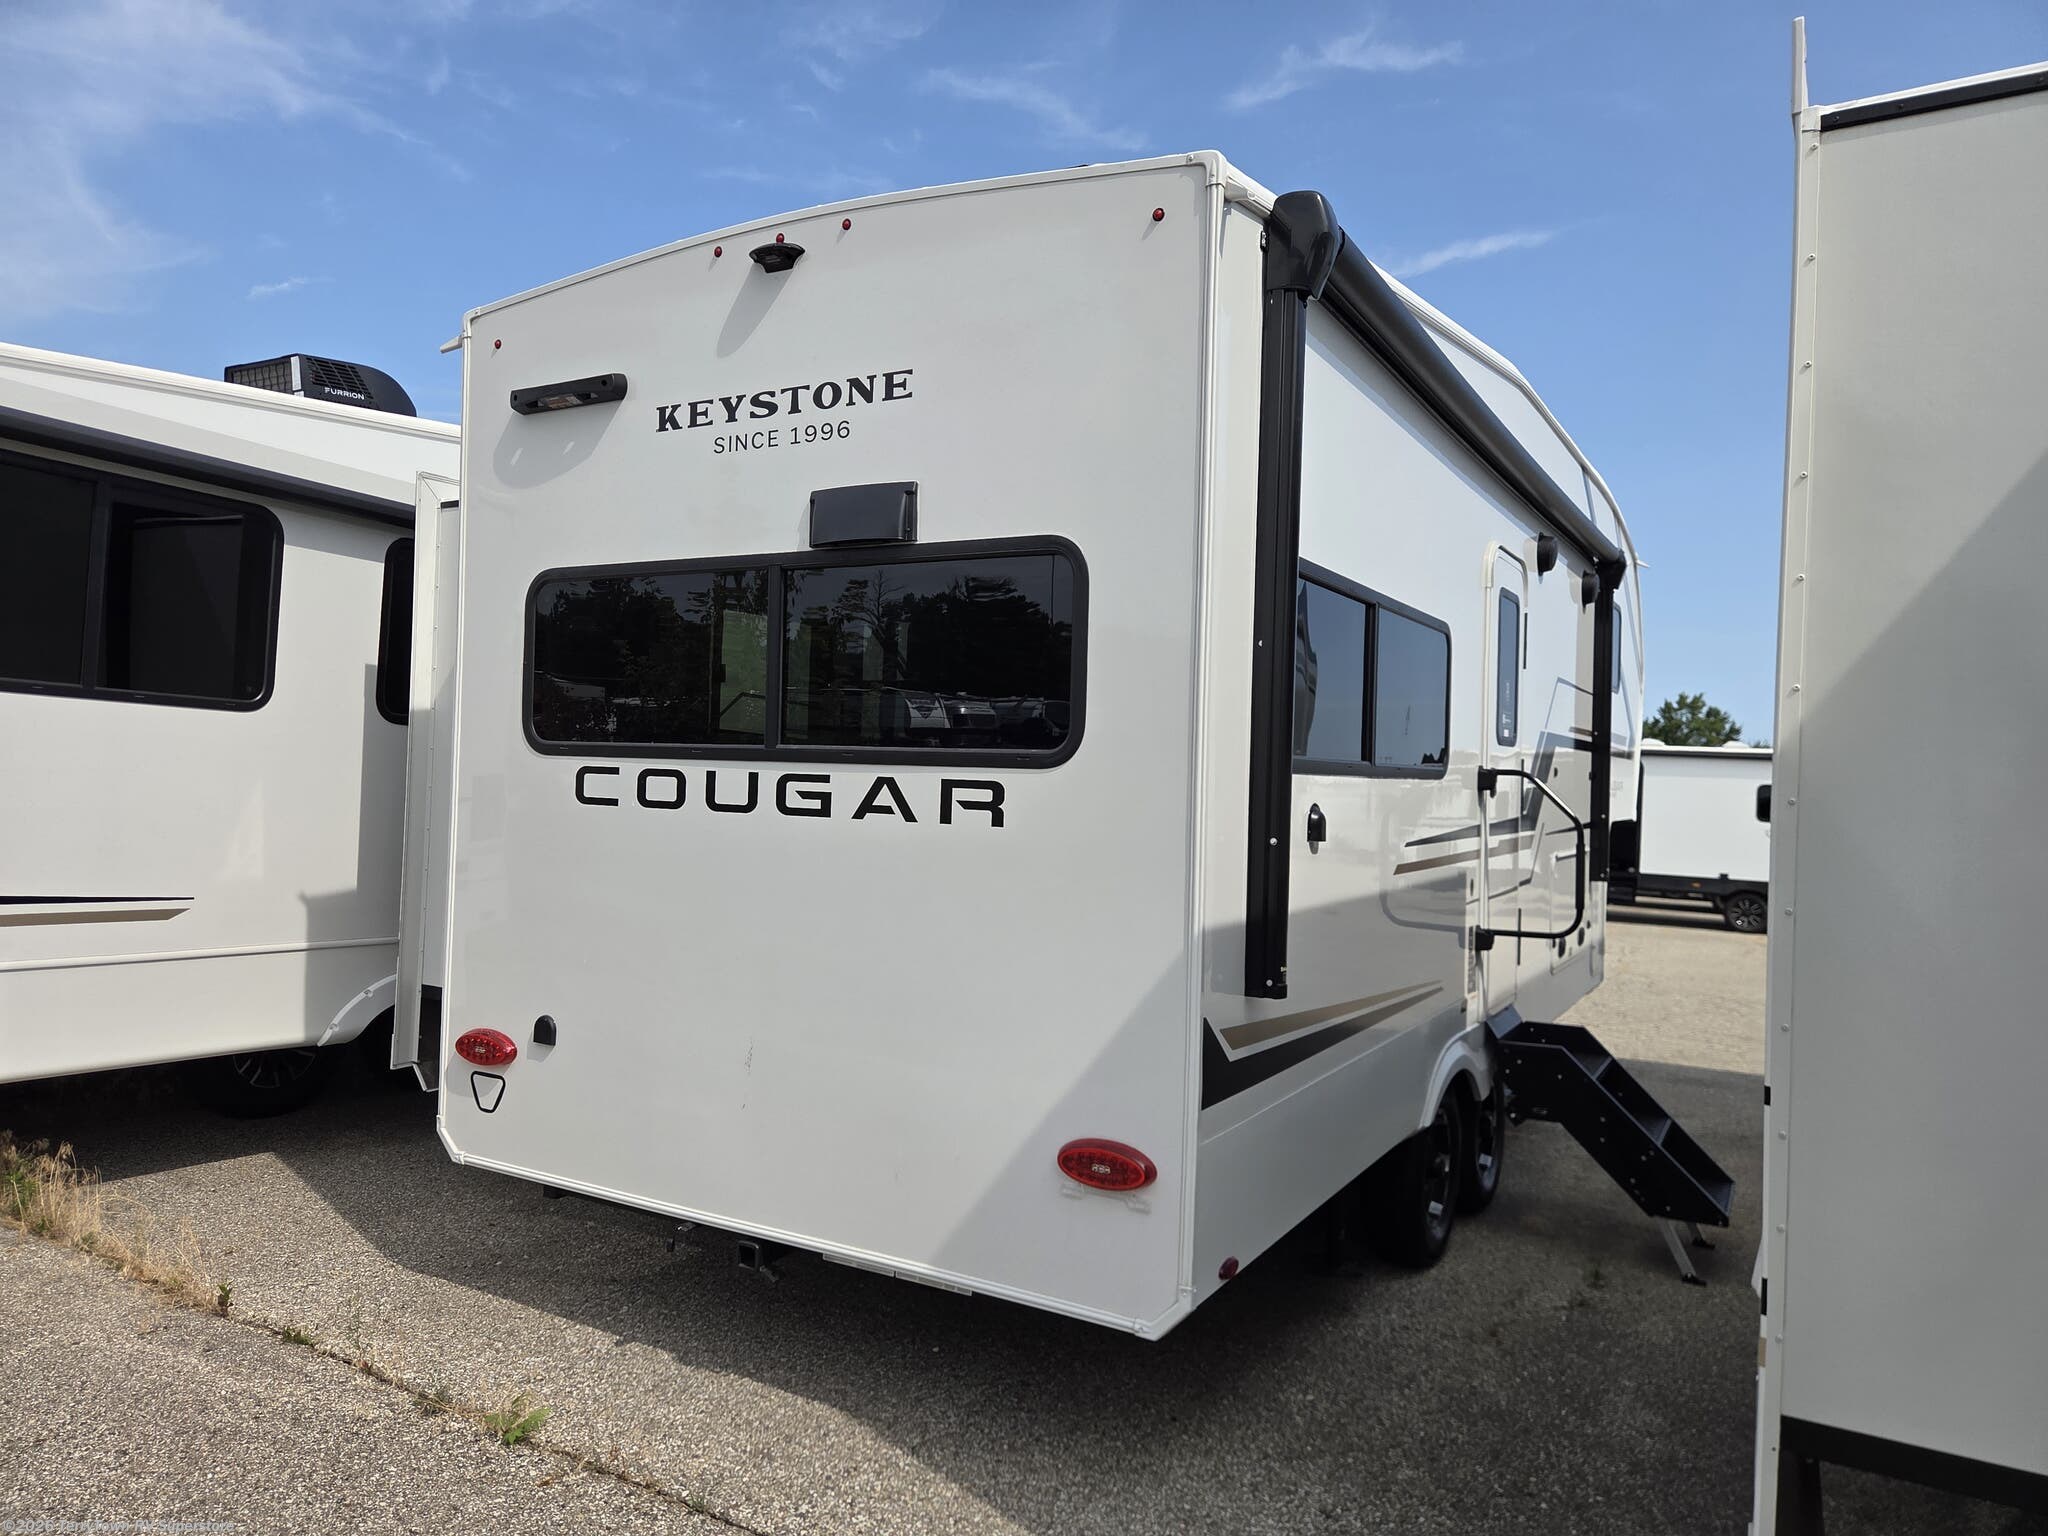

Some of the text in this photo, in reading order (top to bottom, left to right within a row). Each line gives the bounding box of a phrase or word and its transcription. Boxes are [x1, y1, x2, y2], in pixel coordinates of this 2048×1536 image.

[324, 387, 365, 401] FURRION
[655, 368, 914, 433] KEYSTONE
[713, 420, 851, 454] SINCE 1996
[575, 765, 1006, 828] COUGAR
